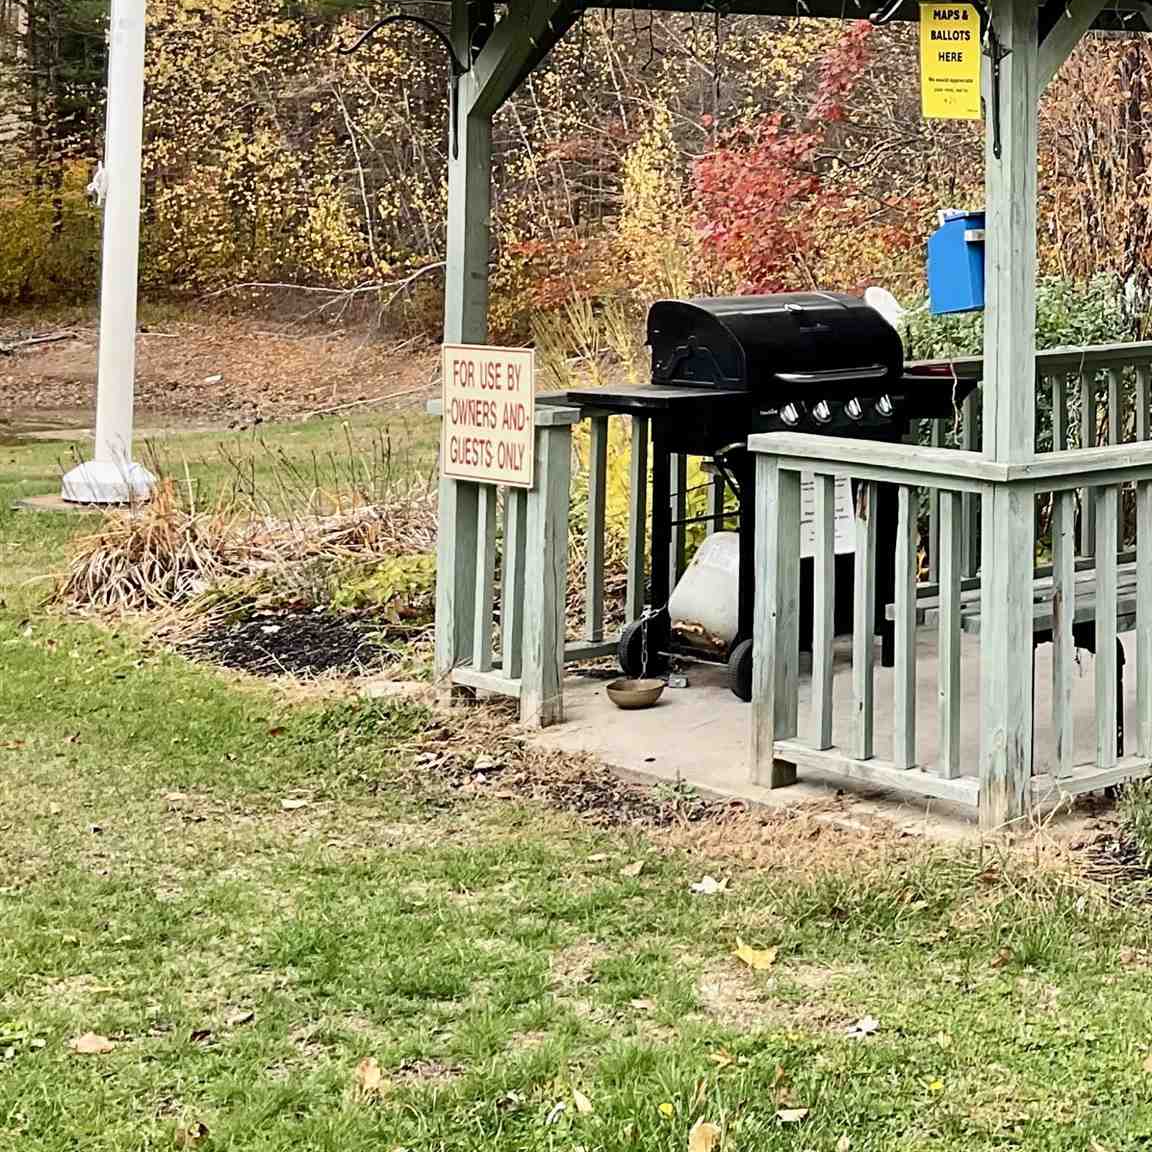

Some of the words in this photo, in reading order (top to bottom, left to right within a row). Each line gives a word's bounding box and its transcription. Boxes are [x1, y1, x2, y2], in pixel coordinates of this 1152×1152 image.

[933, 10, 959, 20] MAPS
[962, 10, 968, 20] &
[931, 30, 970, 40] BALLOTS
[938, 52, 963, 62] HERE
[453, 360, 475, 387] FOR
[480, 362, 501, 390] USE
[507, 364, 522, 391] BY
[451, 399, 497, 429] OWNERS
[502, 403, 525, 431] AND
[450, 435, 492, 467] GUESTS
[497, 442, 525, 470] ONLY
